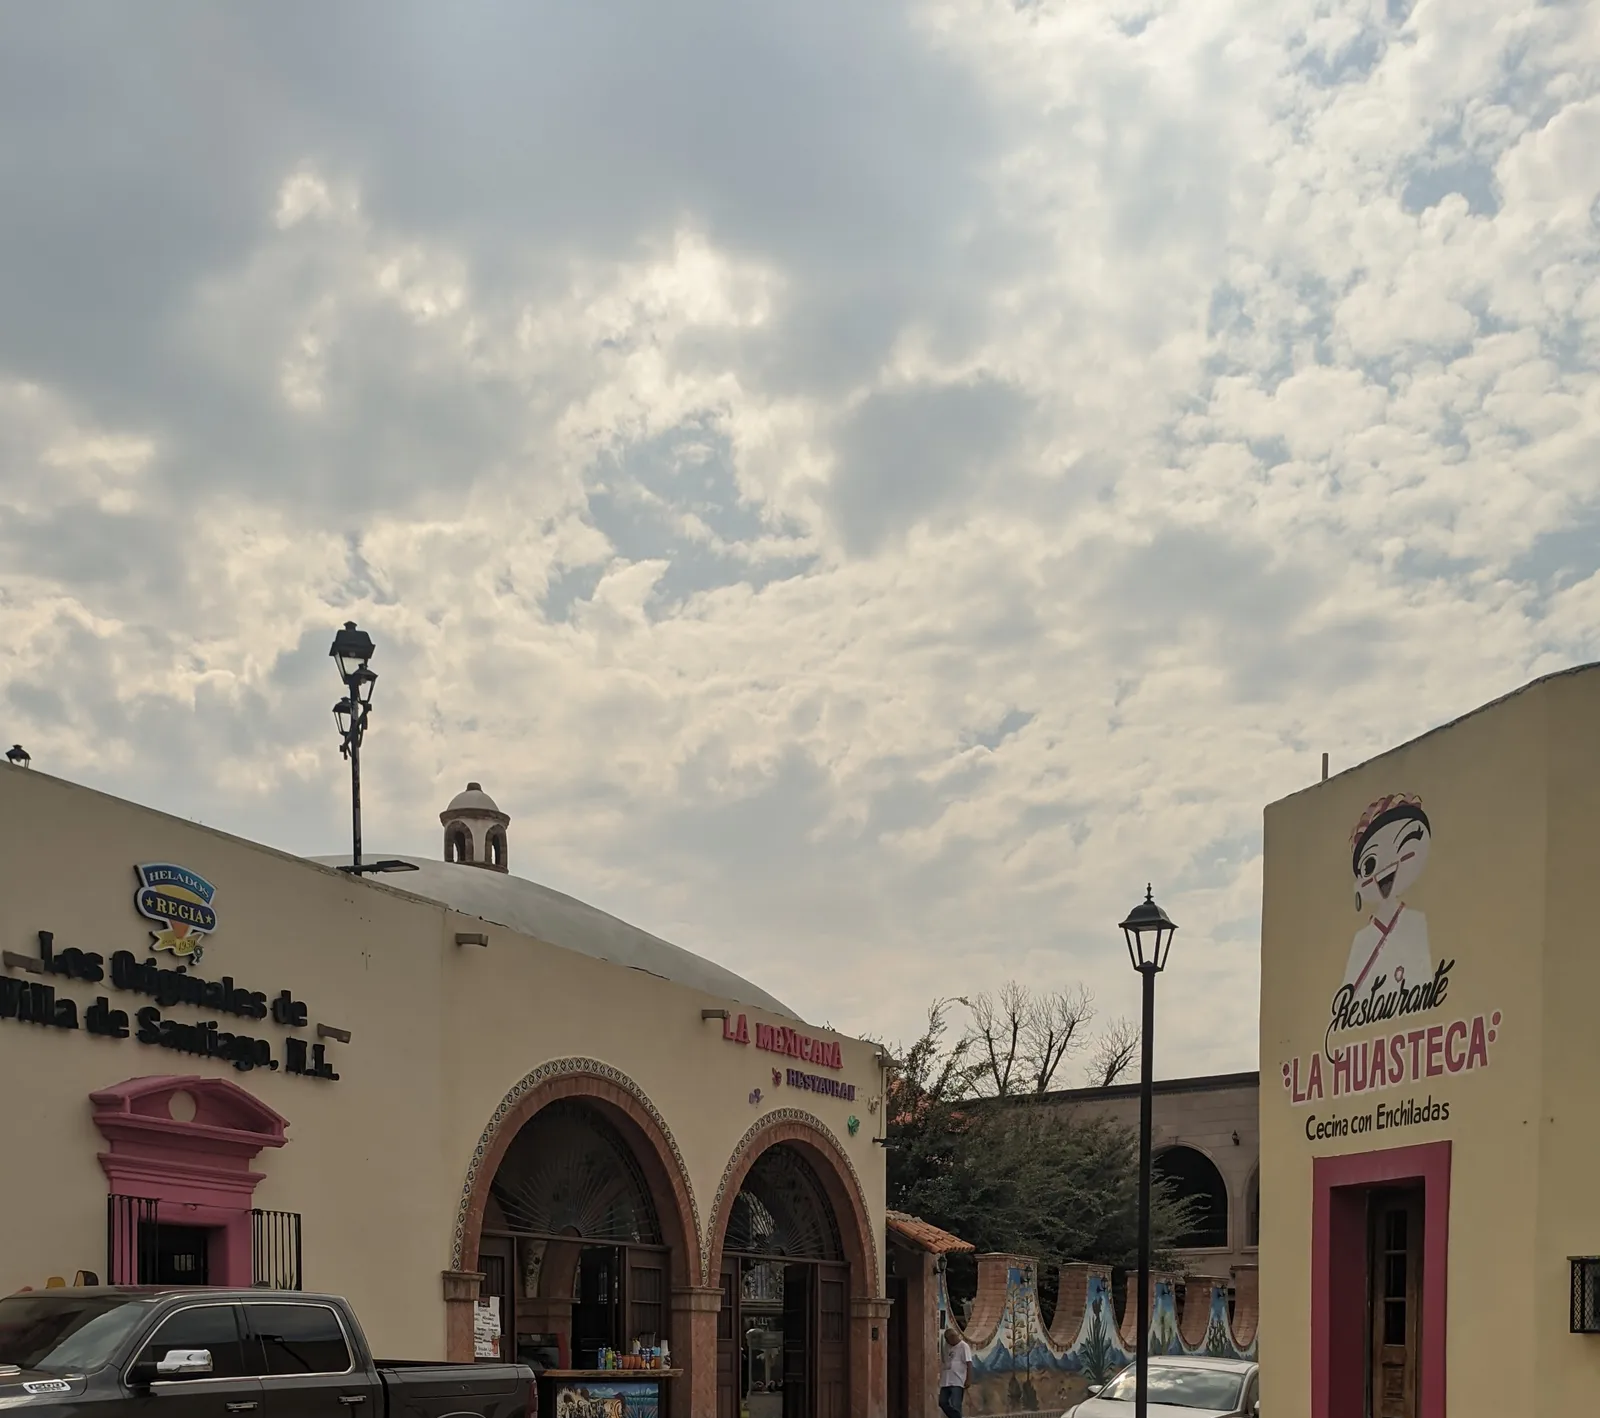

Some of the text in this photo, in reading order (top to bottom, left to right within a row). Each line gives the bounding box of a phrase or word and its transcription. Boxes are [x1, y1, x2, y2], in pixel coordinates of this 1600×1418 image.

[149, 870, 209, 898] HELADOS
[155, 897, 205, 924] REGIA
[38, 930, 308, 1027] Los Originales de
[85, 996, 129, 1039] de
[1325, 959, 1455, 1064] Restaurante
[723, 1013, 843, 1069] LA MEXICANA
[1291, 1016, 1488, 1104] LA HUASTECA
[786, 1068, 856, 1101] RESTAURAN
[1305, 1095, 1450, 1142] Cecina con Enchiladas
